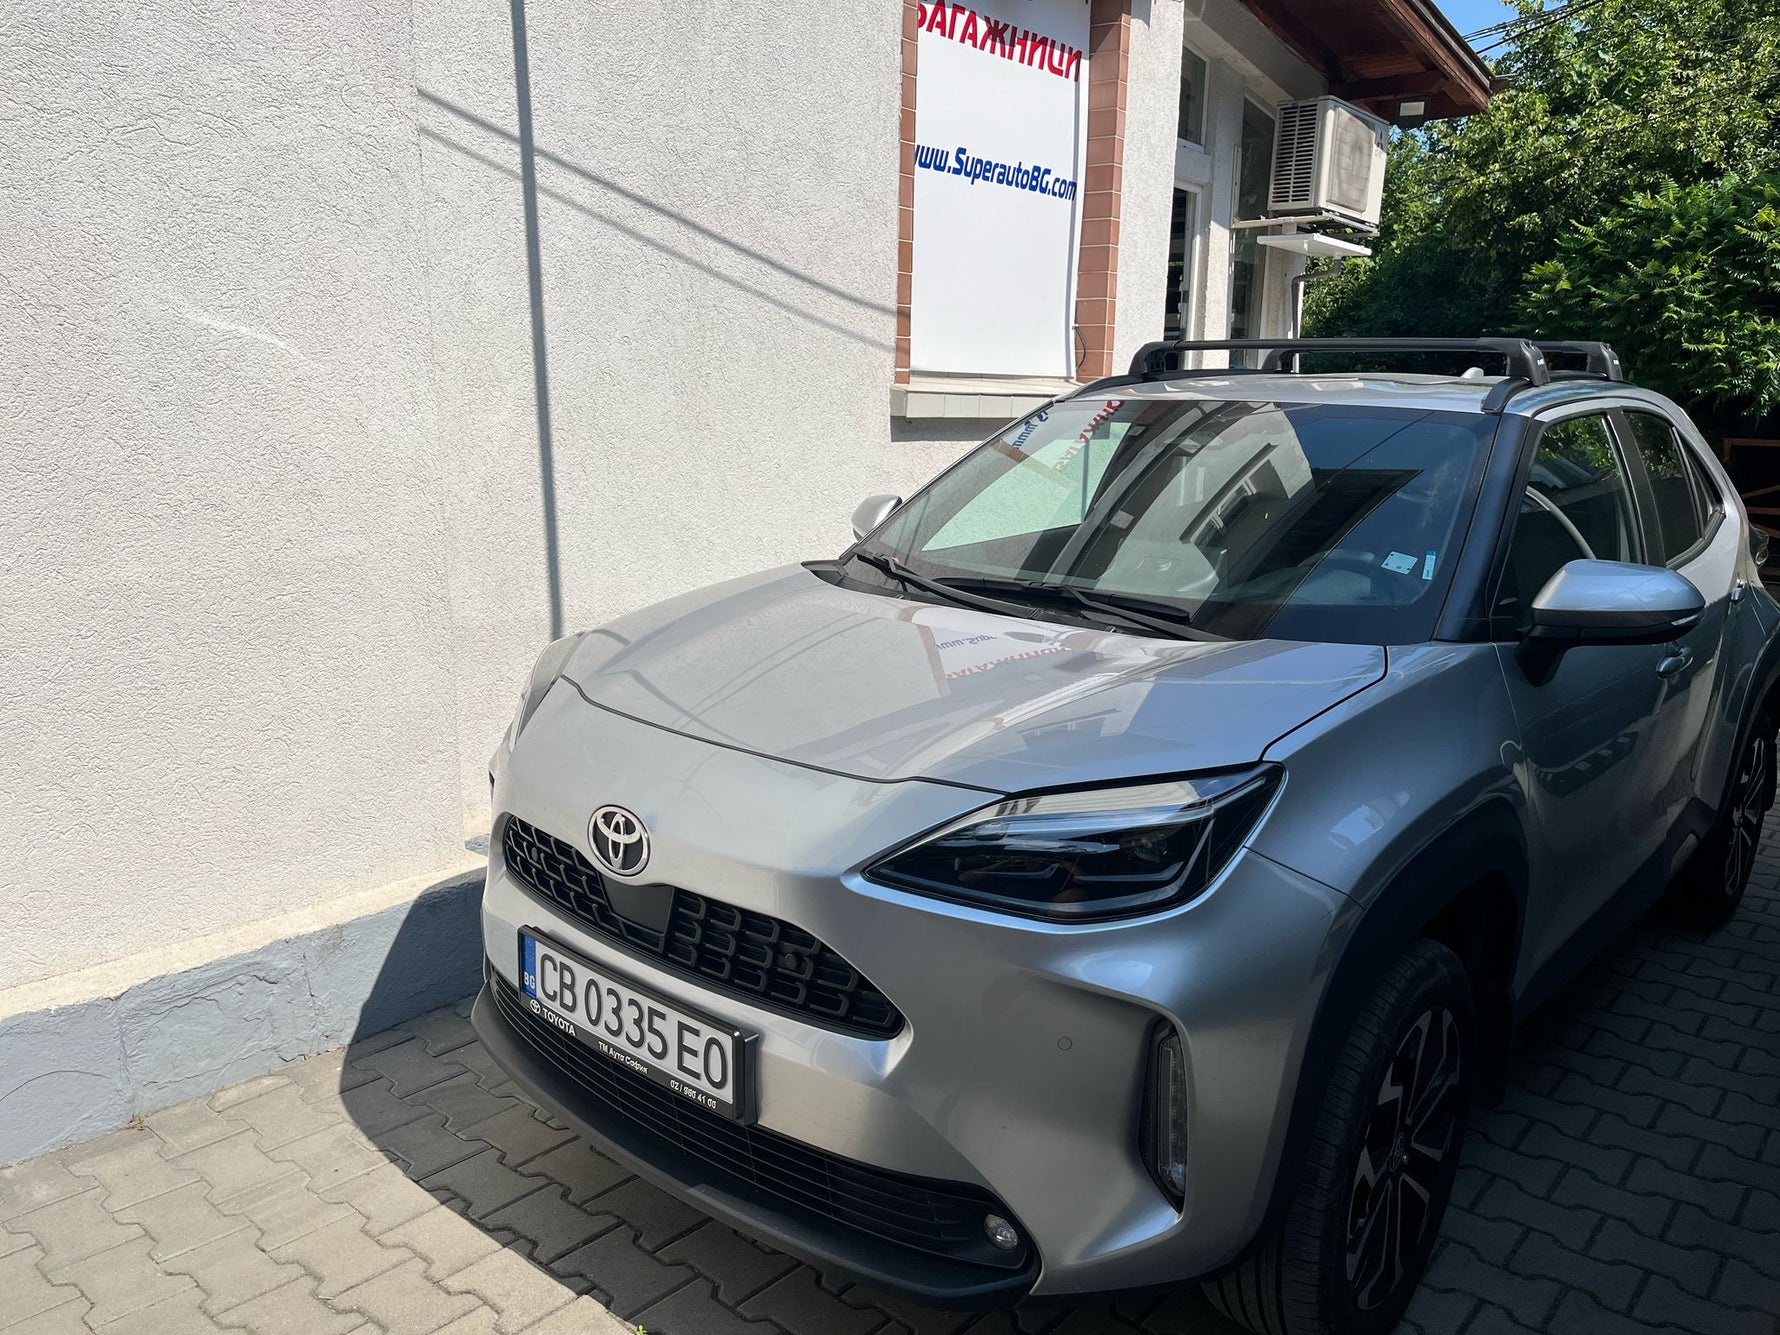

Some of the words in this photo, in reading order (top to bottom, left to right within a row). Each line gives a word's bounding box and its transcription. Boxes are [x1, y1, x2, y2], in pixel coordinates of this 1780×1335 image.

[523, 971, 536, 990] BG
[540, 953, 577, 1014] CB
[584, 977, 668, 1061] 0335
[677, 1020, 728, 1090] EO
[543, 1007, 577, 1037] TOYOTA
